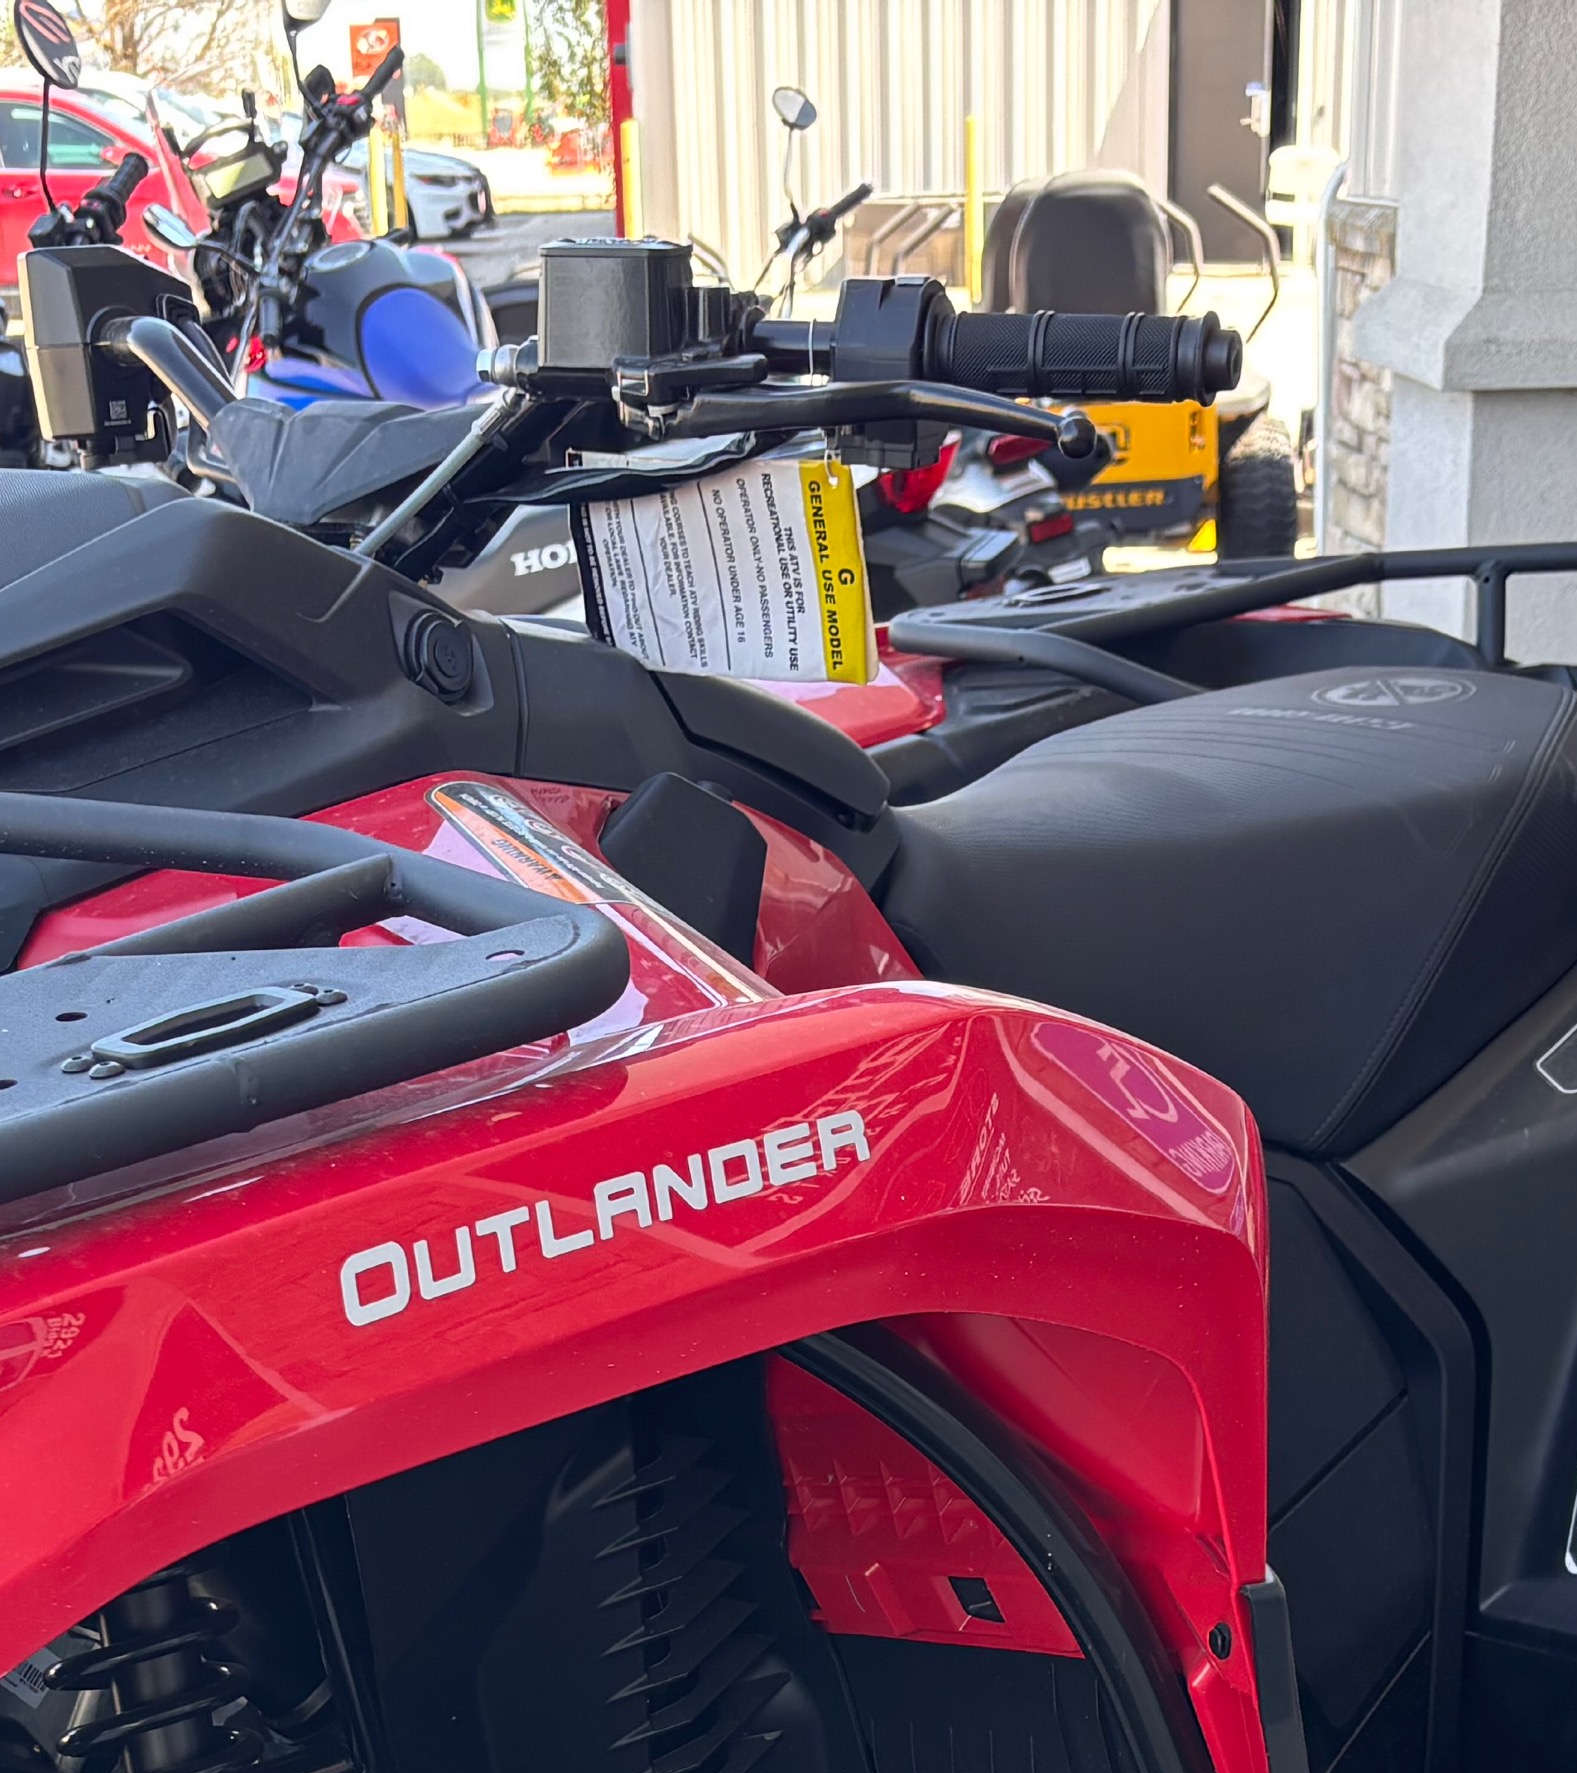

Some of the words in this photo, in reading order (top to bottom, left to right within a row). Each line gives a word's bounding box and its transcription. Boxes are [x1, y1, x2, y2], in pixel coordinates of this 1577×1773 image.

[711, 489, 723, 505] NO
[1060, 489, 1165, 510] USTLER
[761, 473, 785, 555] RECREATIONAL
[808, 480, 829, 563] GENERAL
[715, 507, 736, 564] OPERATOR
[784, 526, 796, 551] THIS
[681, 547, 689, 559] TO
[789, 553, 801, 575] ATV
[736, 478, 756, 534] OPERATOR
[759, 585, 774, 658] PASSENGERS
[778, 557, 790, 580] USE
[838, 568, 855, 585] G
[728, 565, 742, 603] UNDER
[783, 582, 793, 598] OR
[793, 578, 803, 589] IS
[822, 570, 836, 604] USE
[795, 591, 805, 614] FOR
[734, 605, 745, 629] AGE
[785, 600, 798, 645] UTILITY
[685, 621, 697, 659] CONTACT
[737, 631, 746, 643] 16
[826, 609, 843, 670] MODEL
[789, 648, 799, 671] USE
[340, 1110, 870, 1326] OUTLANDER
